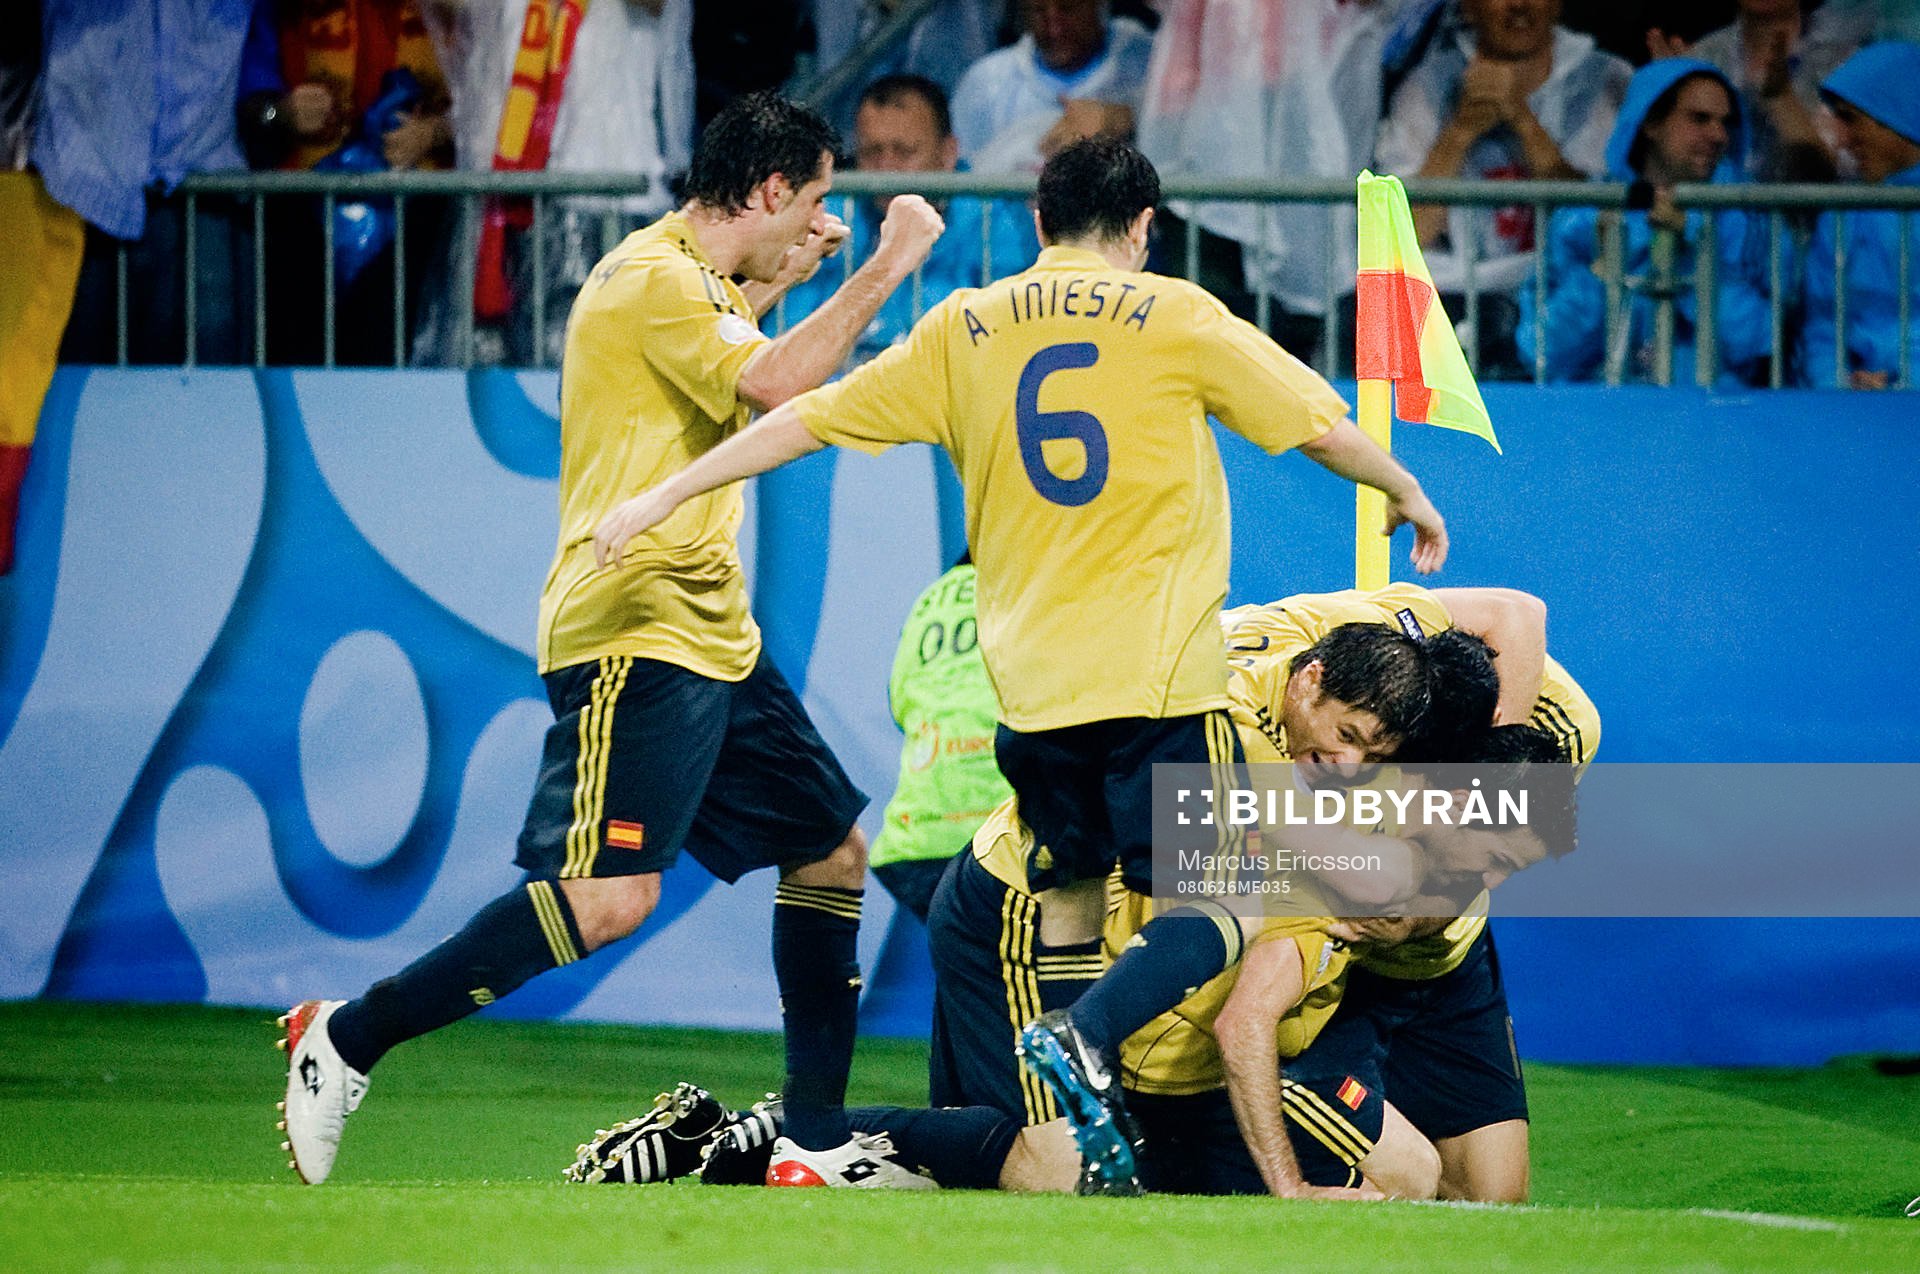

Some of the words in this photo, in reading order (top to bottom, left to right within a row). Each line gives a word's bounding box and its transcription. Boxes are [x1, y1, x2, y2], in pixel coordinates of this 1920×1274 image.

[963, 308, 998, 347] A.
[1009, 279, 1156, 332] INIESTA
[1015, 341, 1109, 508] 6
